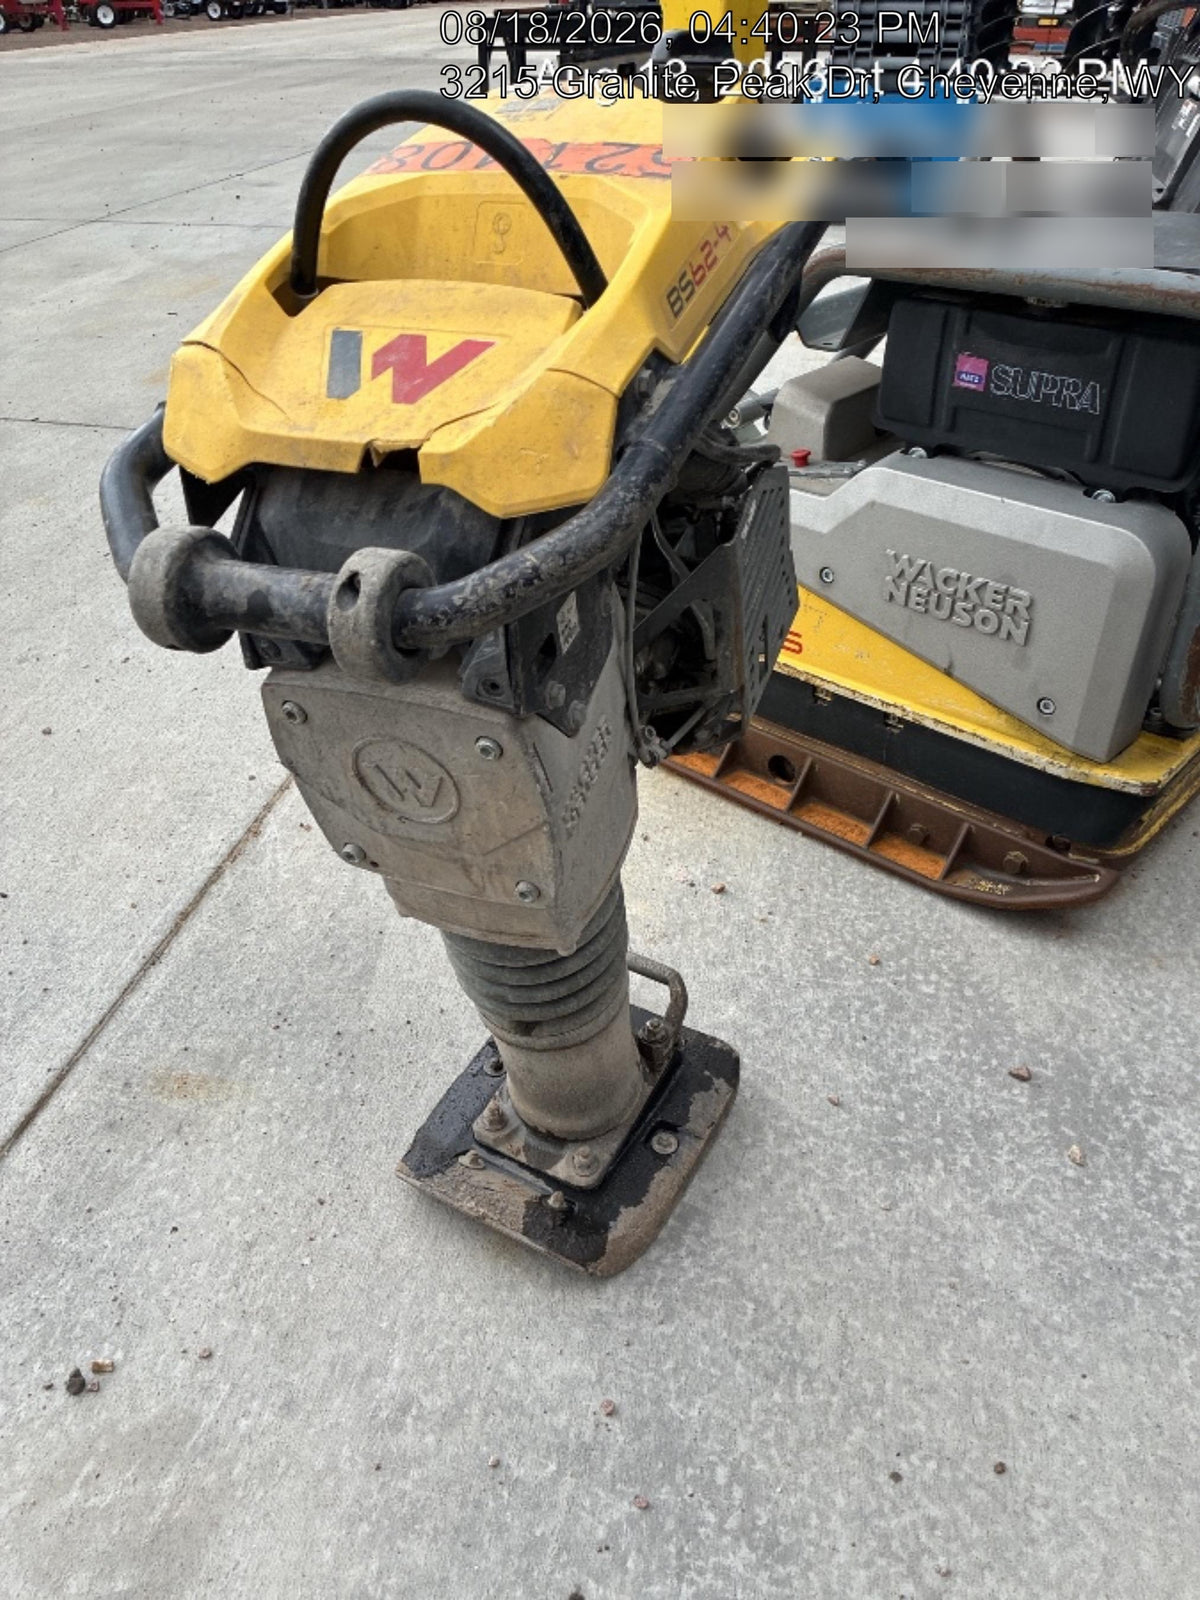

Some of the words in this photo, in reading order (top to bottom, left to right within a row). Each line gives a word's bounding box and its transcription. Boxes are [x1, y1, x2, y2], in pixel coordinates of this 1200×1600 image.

[666, 224, 731, 318] BS62-4
[990, 363, 1100, 415] SUPRA
[884, 575, 1030, 646] NEUSON
[885, 549, 1031, 620] WACKER
